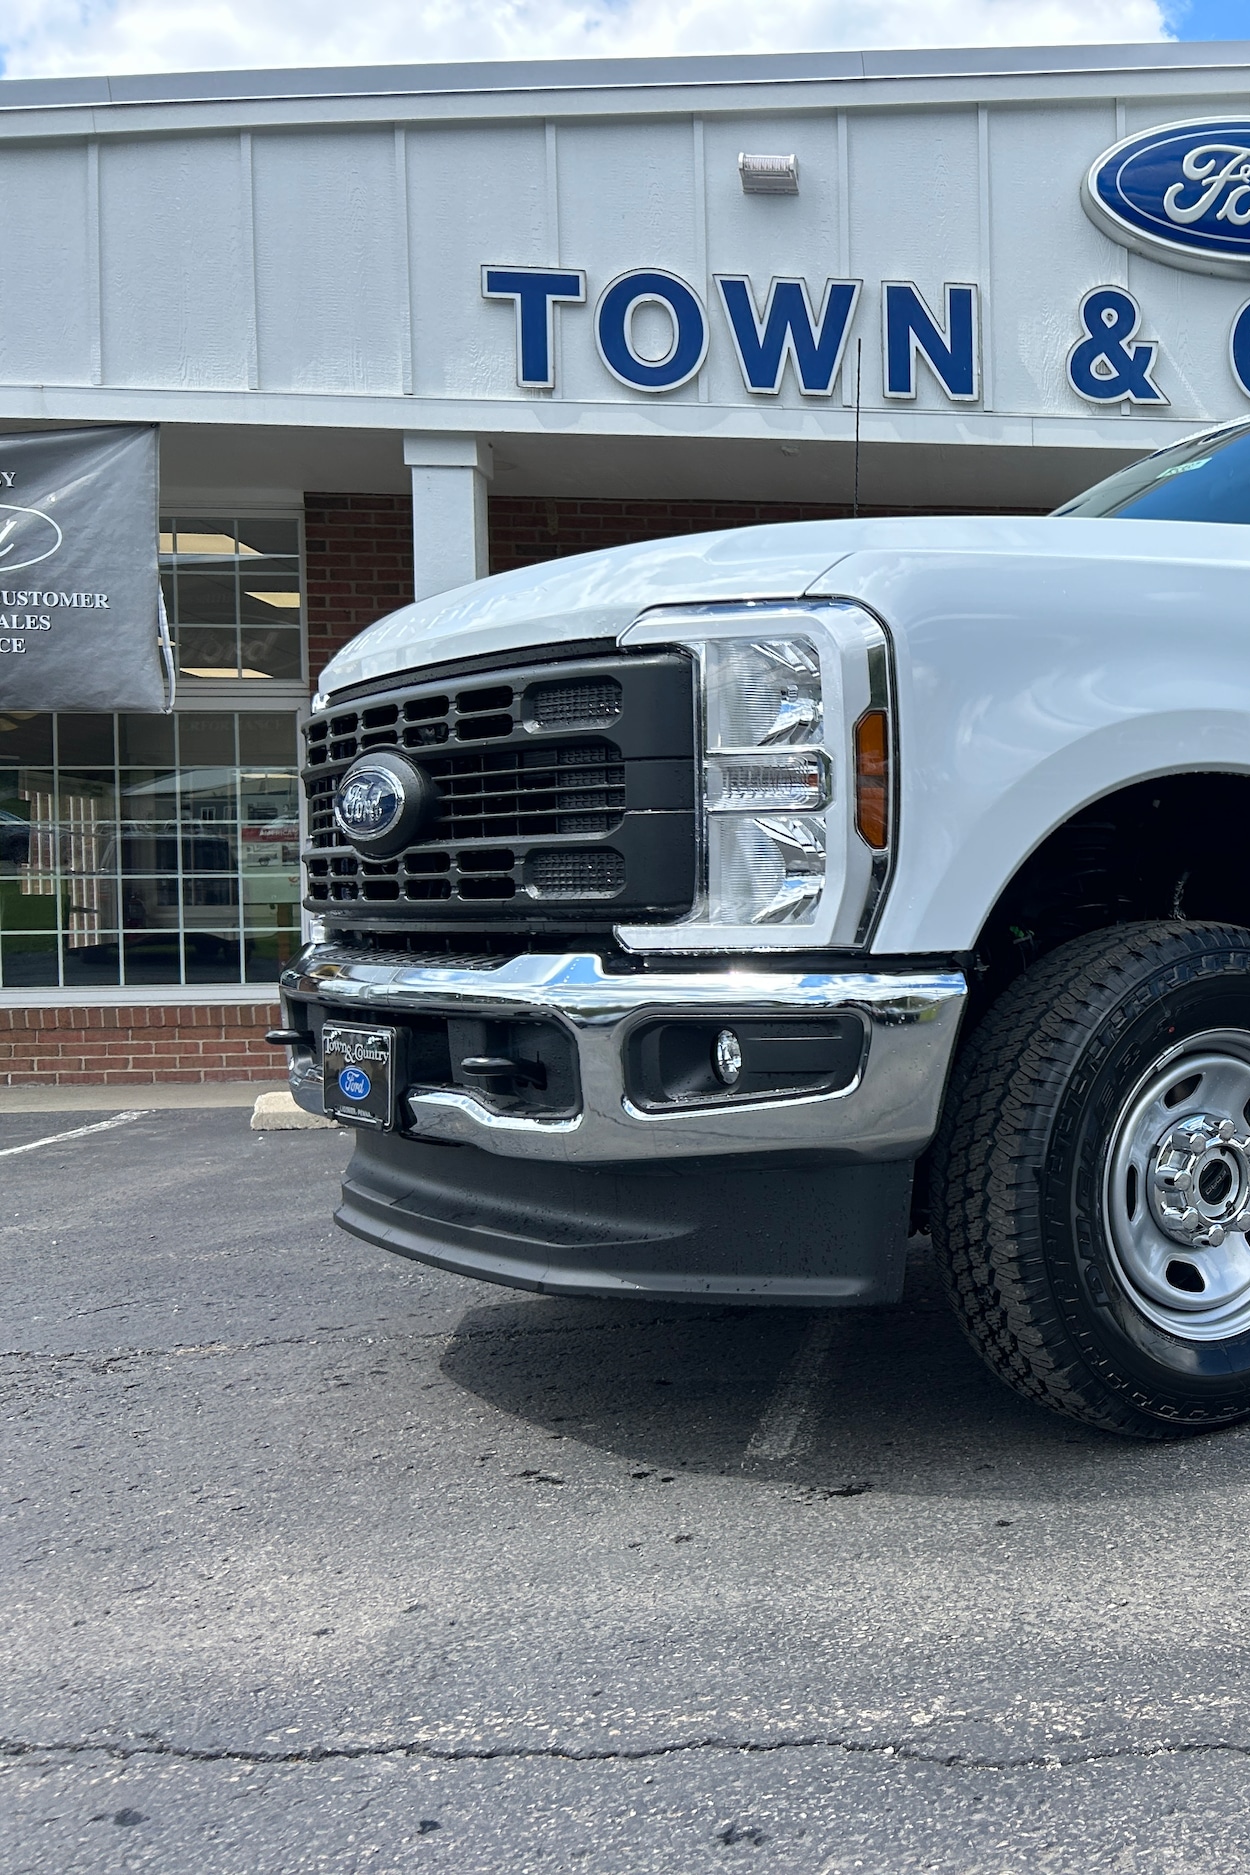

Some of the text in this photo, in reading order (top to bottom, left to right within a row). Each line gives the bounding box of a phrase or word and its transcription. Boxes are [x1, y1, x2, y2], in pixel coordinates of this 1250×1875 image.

[480, 264, 979, 401] TOWN
[1065, 284, 1170, 406] &
[0, 471, 16, 488] Y
[0, 590, 110, 609] USTOMER
[0, 614, 51, 631] ALES
[0, 637, 26, 653] CE
[343, 782, 383, 822] Ford
[324, 1035, 389, 1065] Town & Country
[345, 1071, 364, 1094] Ford
